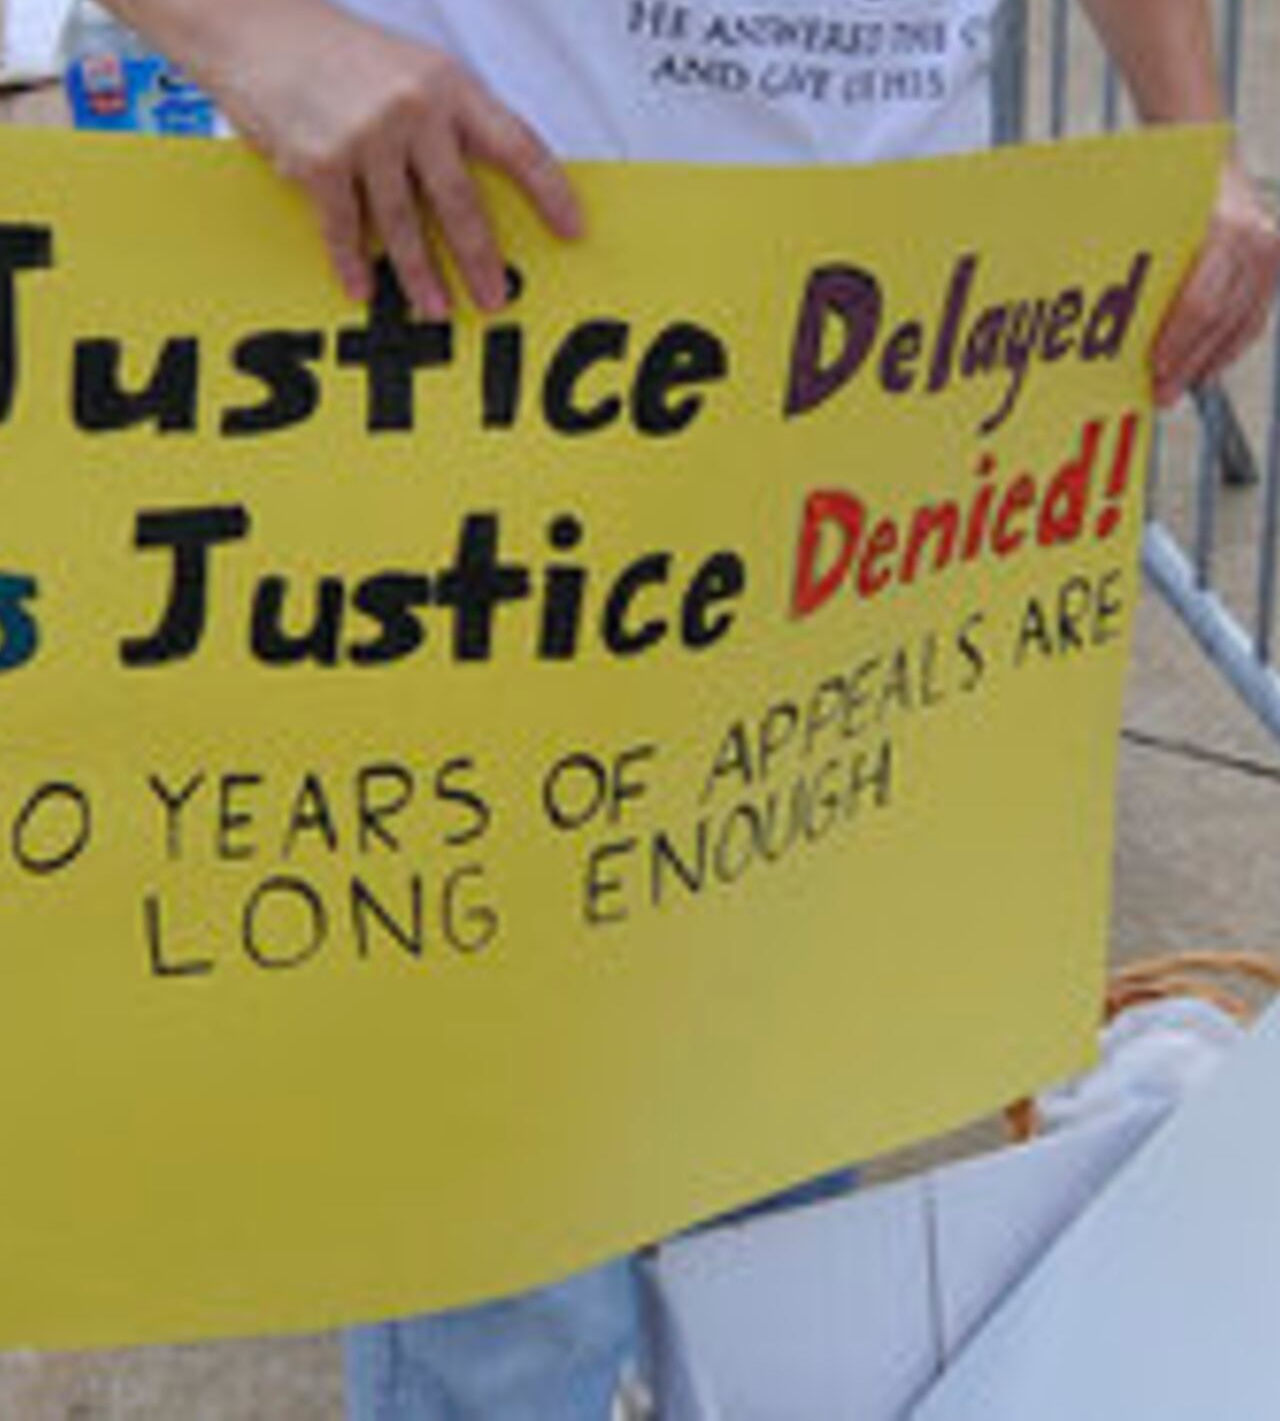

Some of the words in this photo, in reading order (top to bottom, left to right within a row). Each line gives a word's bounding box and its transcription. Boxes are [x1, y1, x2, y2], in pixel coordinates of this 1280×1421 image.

[652, 55, 750, 94] AND
[782, 251, 1154, 435] Delayed
[120, 504, 746, 668] Justice
[790, 412, 1139, 622] Denied!
[147, 758, 491, 862] YEARS
[543, 745, 656, 833] OF
[701, 613, 987, 805] APPEALS
[1012, 568, 1122, 669] ARE
[143, 864, 499, 978] LONG
[582, 737, 893, 927] ENOUGH
